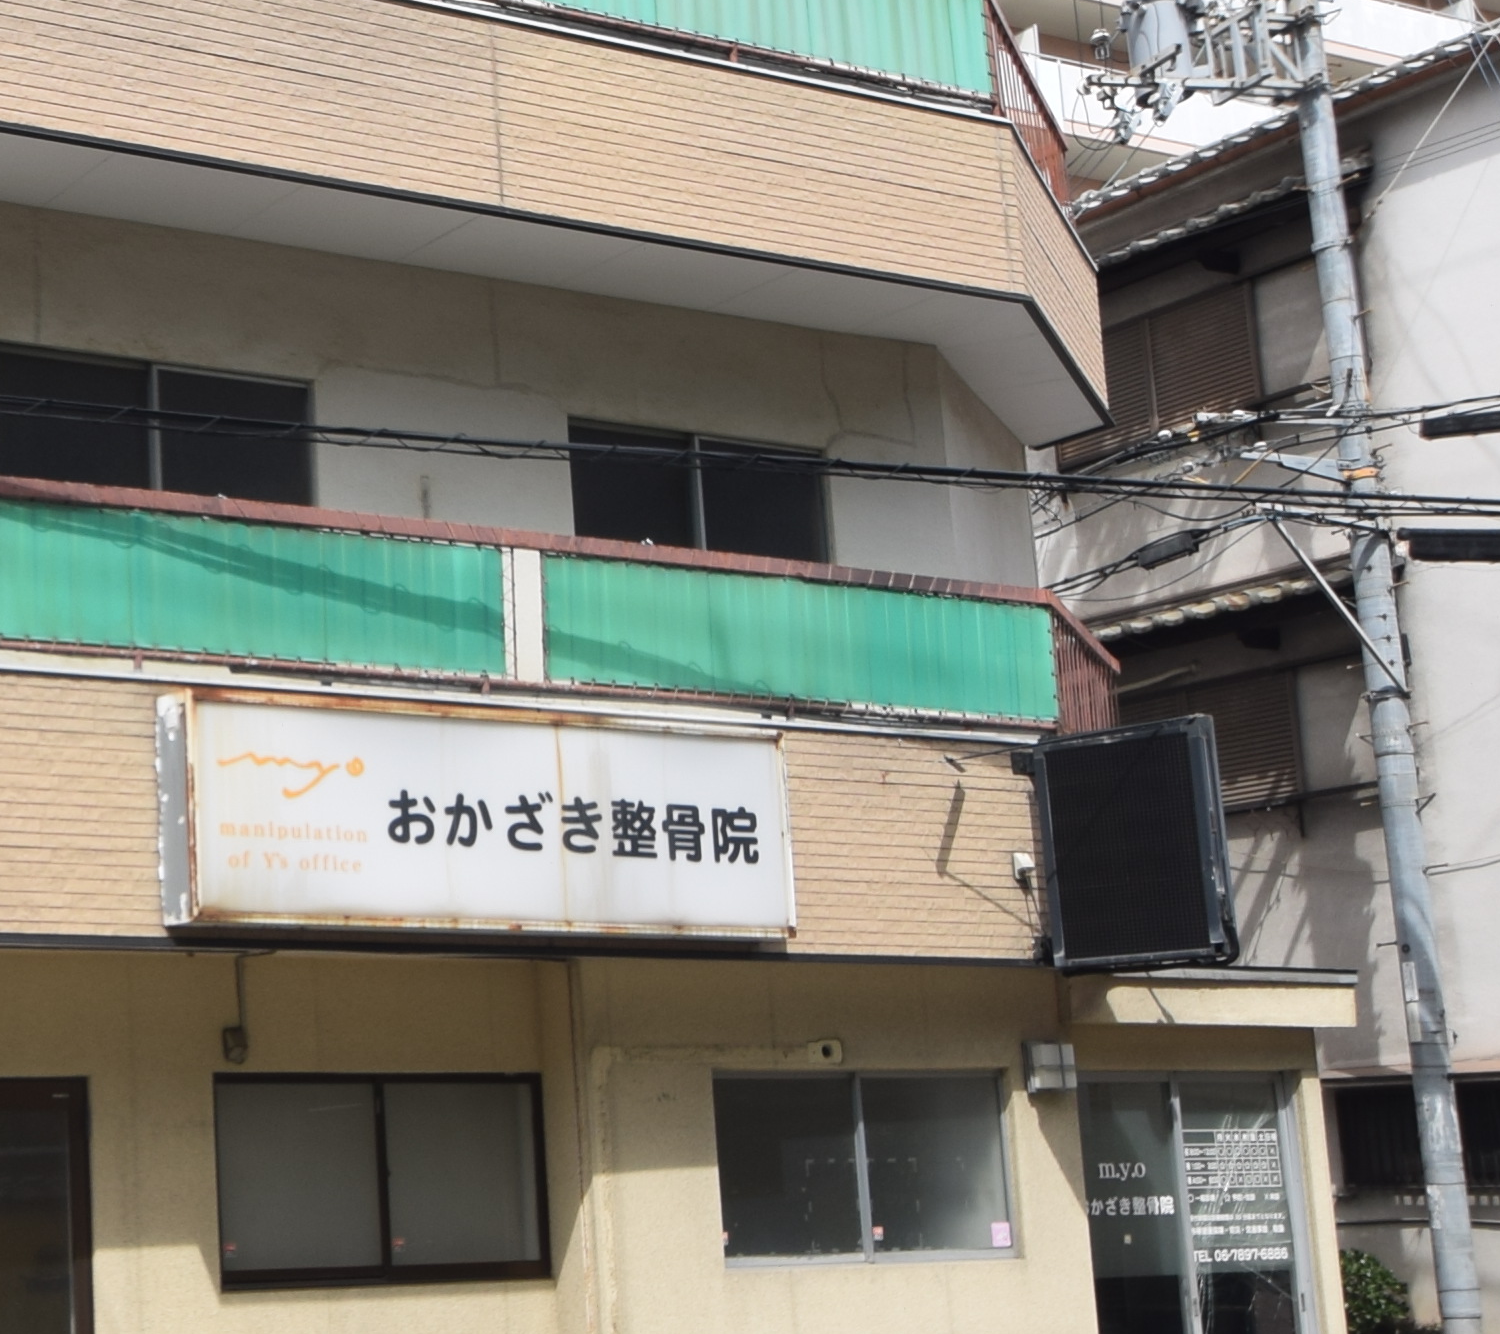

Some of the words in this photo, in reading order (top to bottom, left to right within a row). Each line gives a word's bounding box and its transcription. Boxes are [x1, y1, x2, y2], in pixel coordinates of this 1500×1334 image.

[219, 821, 369, 843] manipulation
[386, 788, 760, 865] おかざき整骨院
[227, 849, 252, 869] of
[299, 852, 363, 873] office
[1098, 1161, 1147, 1182] m.y.o
[1193, 1249, 1213, 1263] TEL
